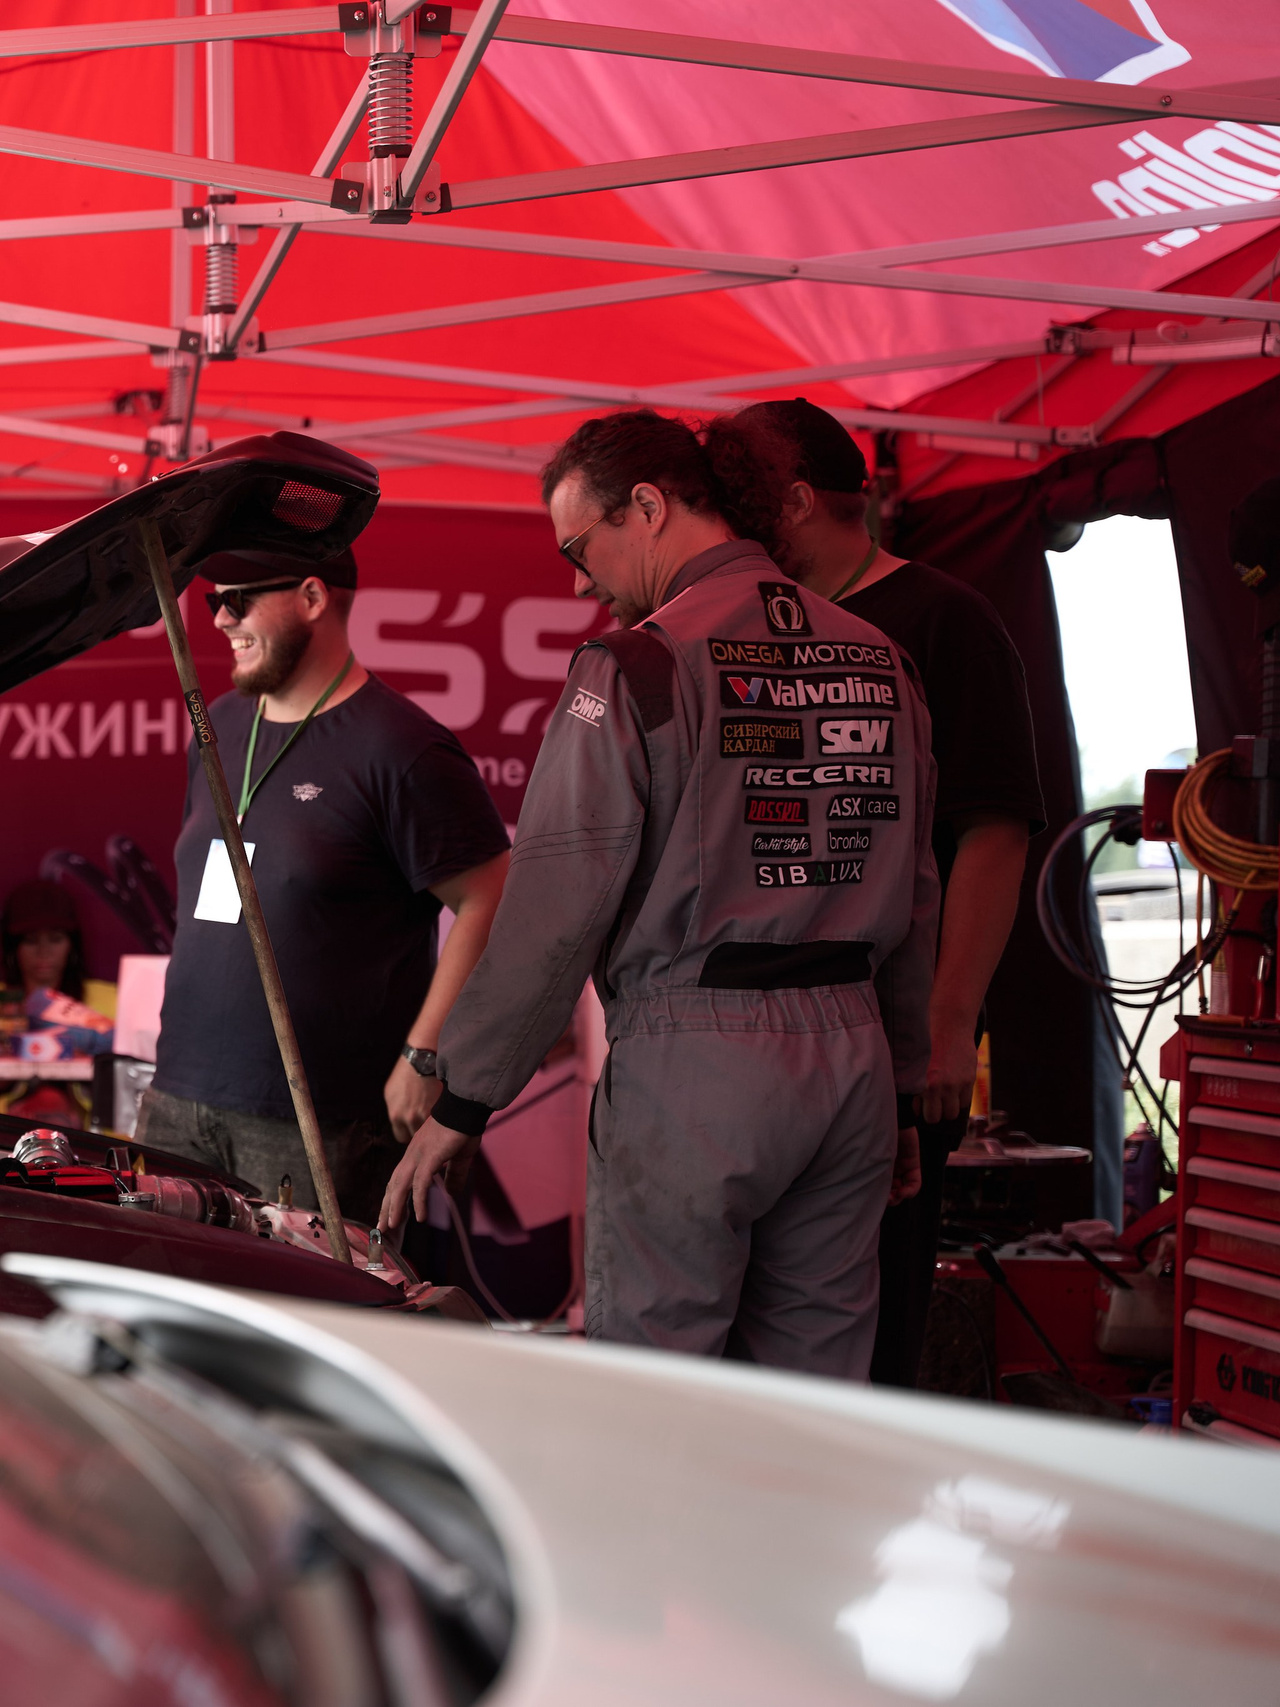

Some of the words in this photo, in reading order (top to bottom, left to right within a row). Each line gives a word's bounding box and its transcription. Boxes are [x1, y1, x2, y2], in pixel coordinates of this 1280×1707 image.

[711, 642, 786, 666] OMEGA
[793, 644, 891, 666] MOTORS
[765, 676, 894, 706] Valvoline
[571, 692, 606, 721] OMP
[723, 722, 801, 740] СИБИРСКИЙ
[820, 719, 891, 754] SCW
[723, 739, 776, 754] КАРДАН
[745, 765, 891, 786] RECERA
[828, 797, 862, 817] ASX
[867, 799, 897, 815] care
[829, 831, 870, 850] bronko
